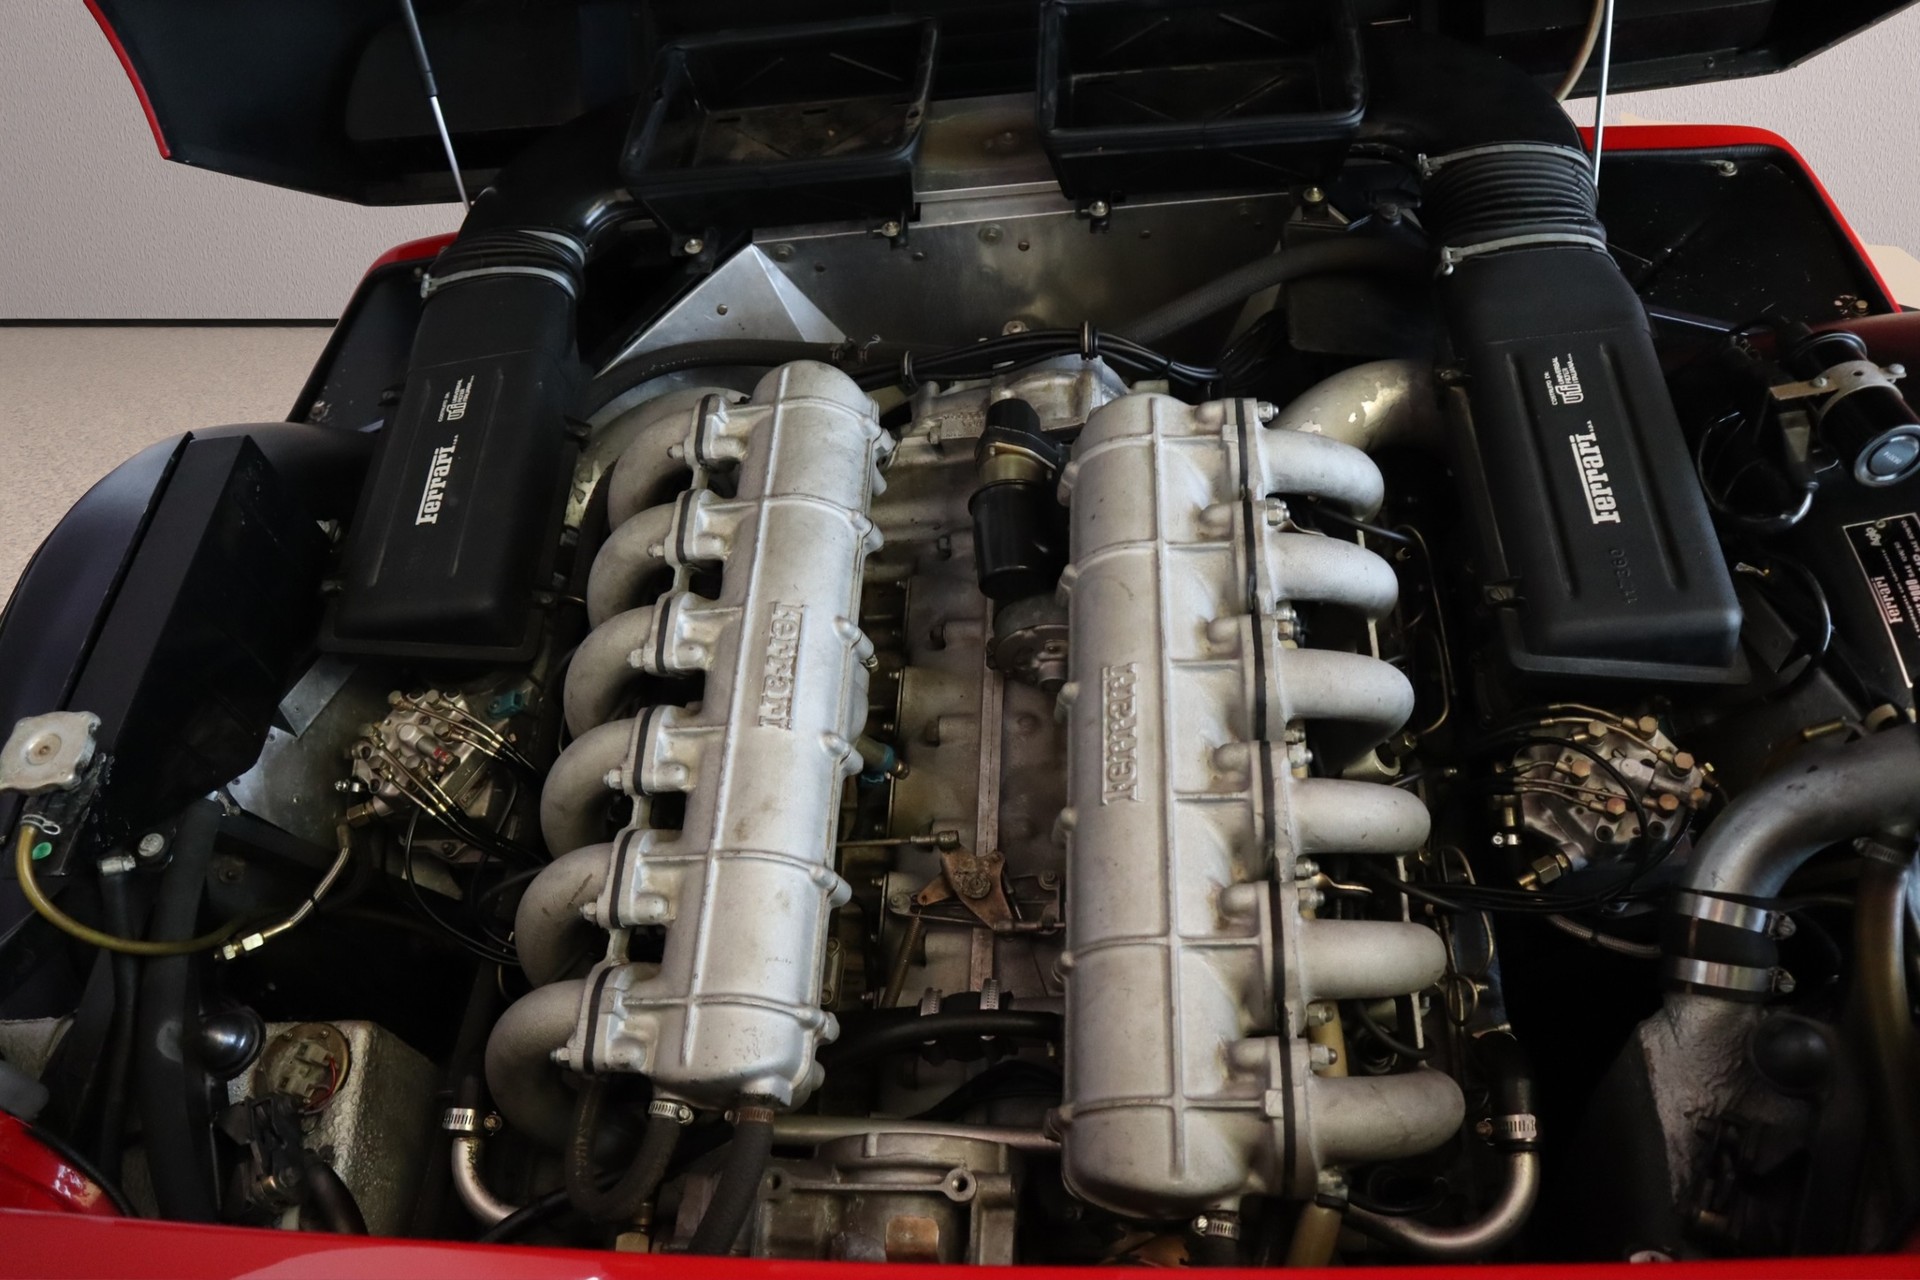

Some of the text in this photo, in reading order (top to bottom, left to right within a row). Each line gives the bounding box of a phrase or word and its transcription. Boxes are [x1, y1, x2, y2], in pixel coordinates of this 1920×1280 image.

[1552, 356, 1565, 385] UNIVERSAL
[415, 445, 456, 525] Ferrari
[1569, 432, 1621, 524] Ferrari
[1871, 576, 1903, 624] Ferrari
[758, 601, 803, 730] Ferrari
[1101, 662, 1138, 804] Ferrari
